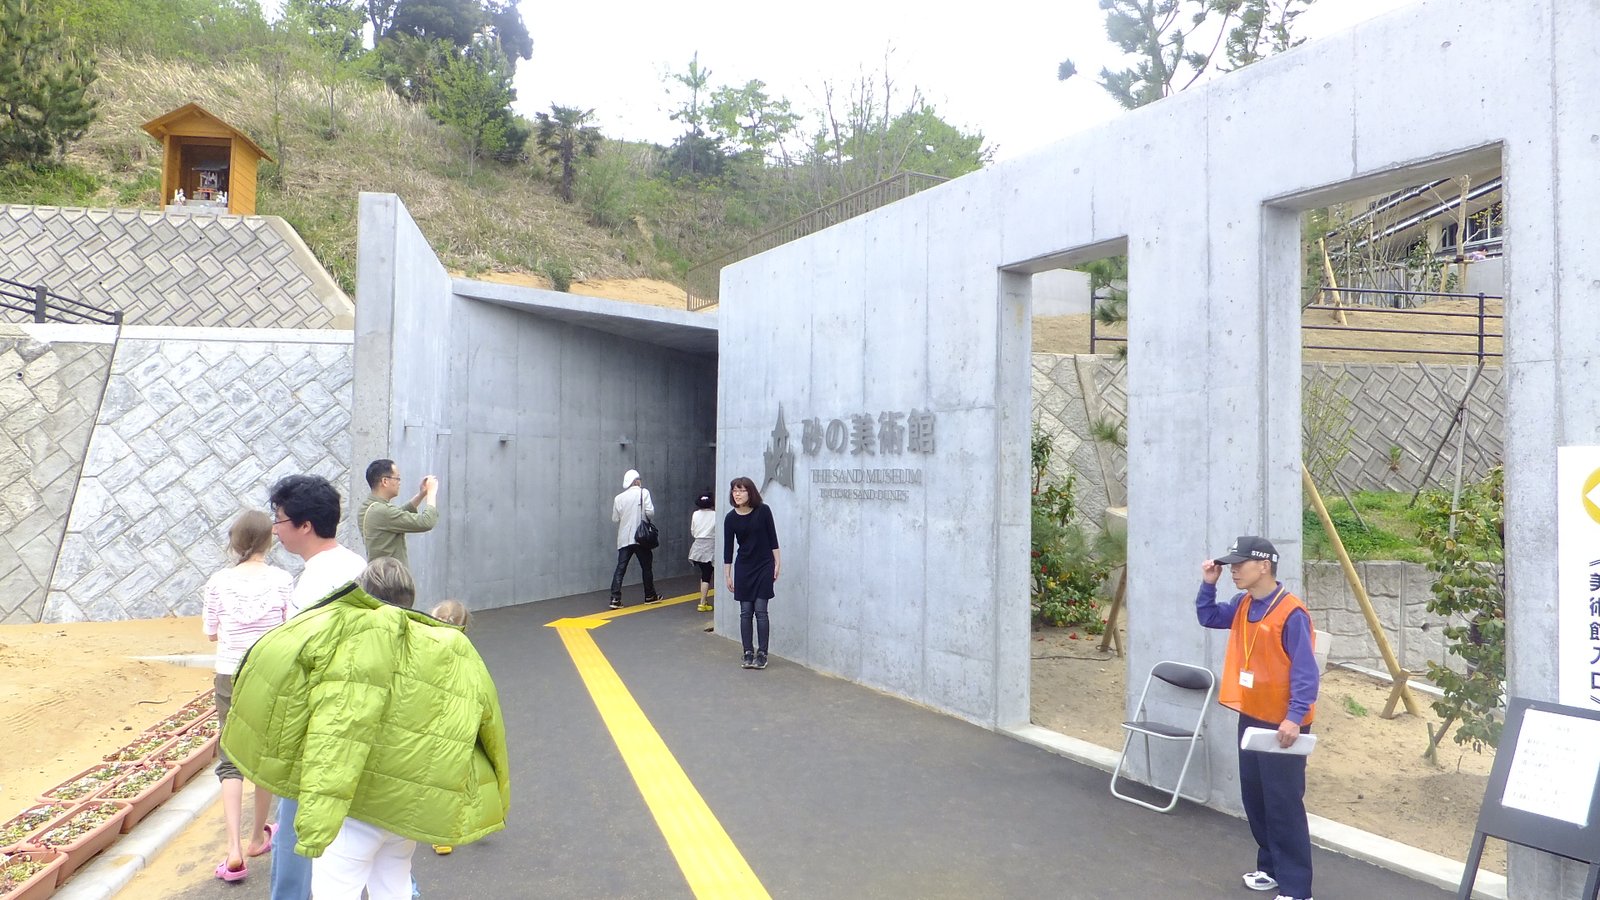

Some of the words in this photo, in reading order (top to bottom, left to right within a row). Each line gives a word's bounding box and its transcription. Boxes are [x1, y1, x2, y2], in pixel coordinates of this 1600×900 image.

[801, 407, 937, 457] 砂の美術館
[811, 468, 832, 484] THE
[832, 468, 864, 484] SAND
[866, 468, 923, 486] MUSEUM
[853, 488, 877, 501] SAND
[1251, 550, 1271, 559] STAFF
